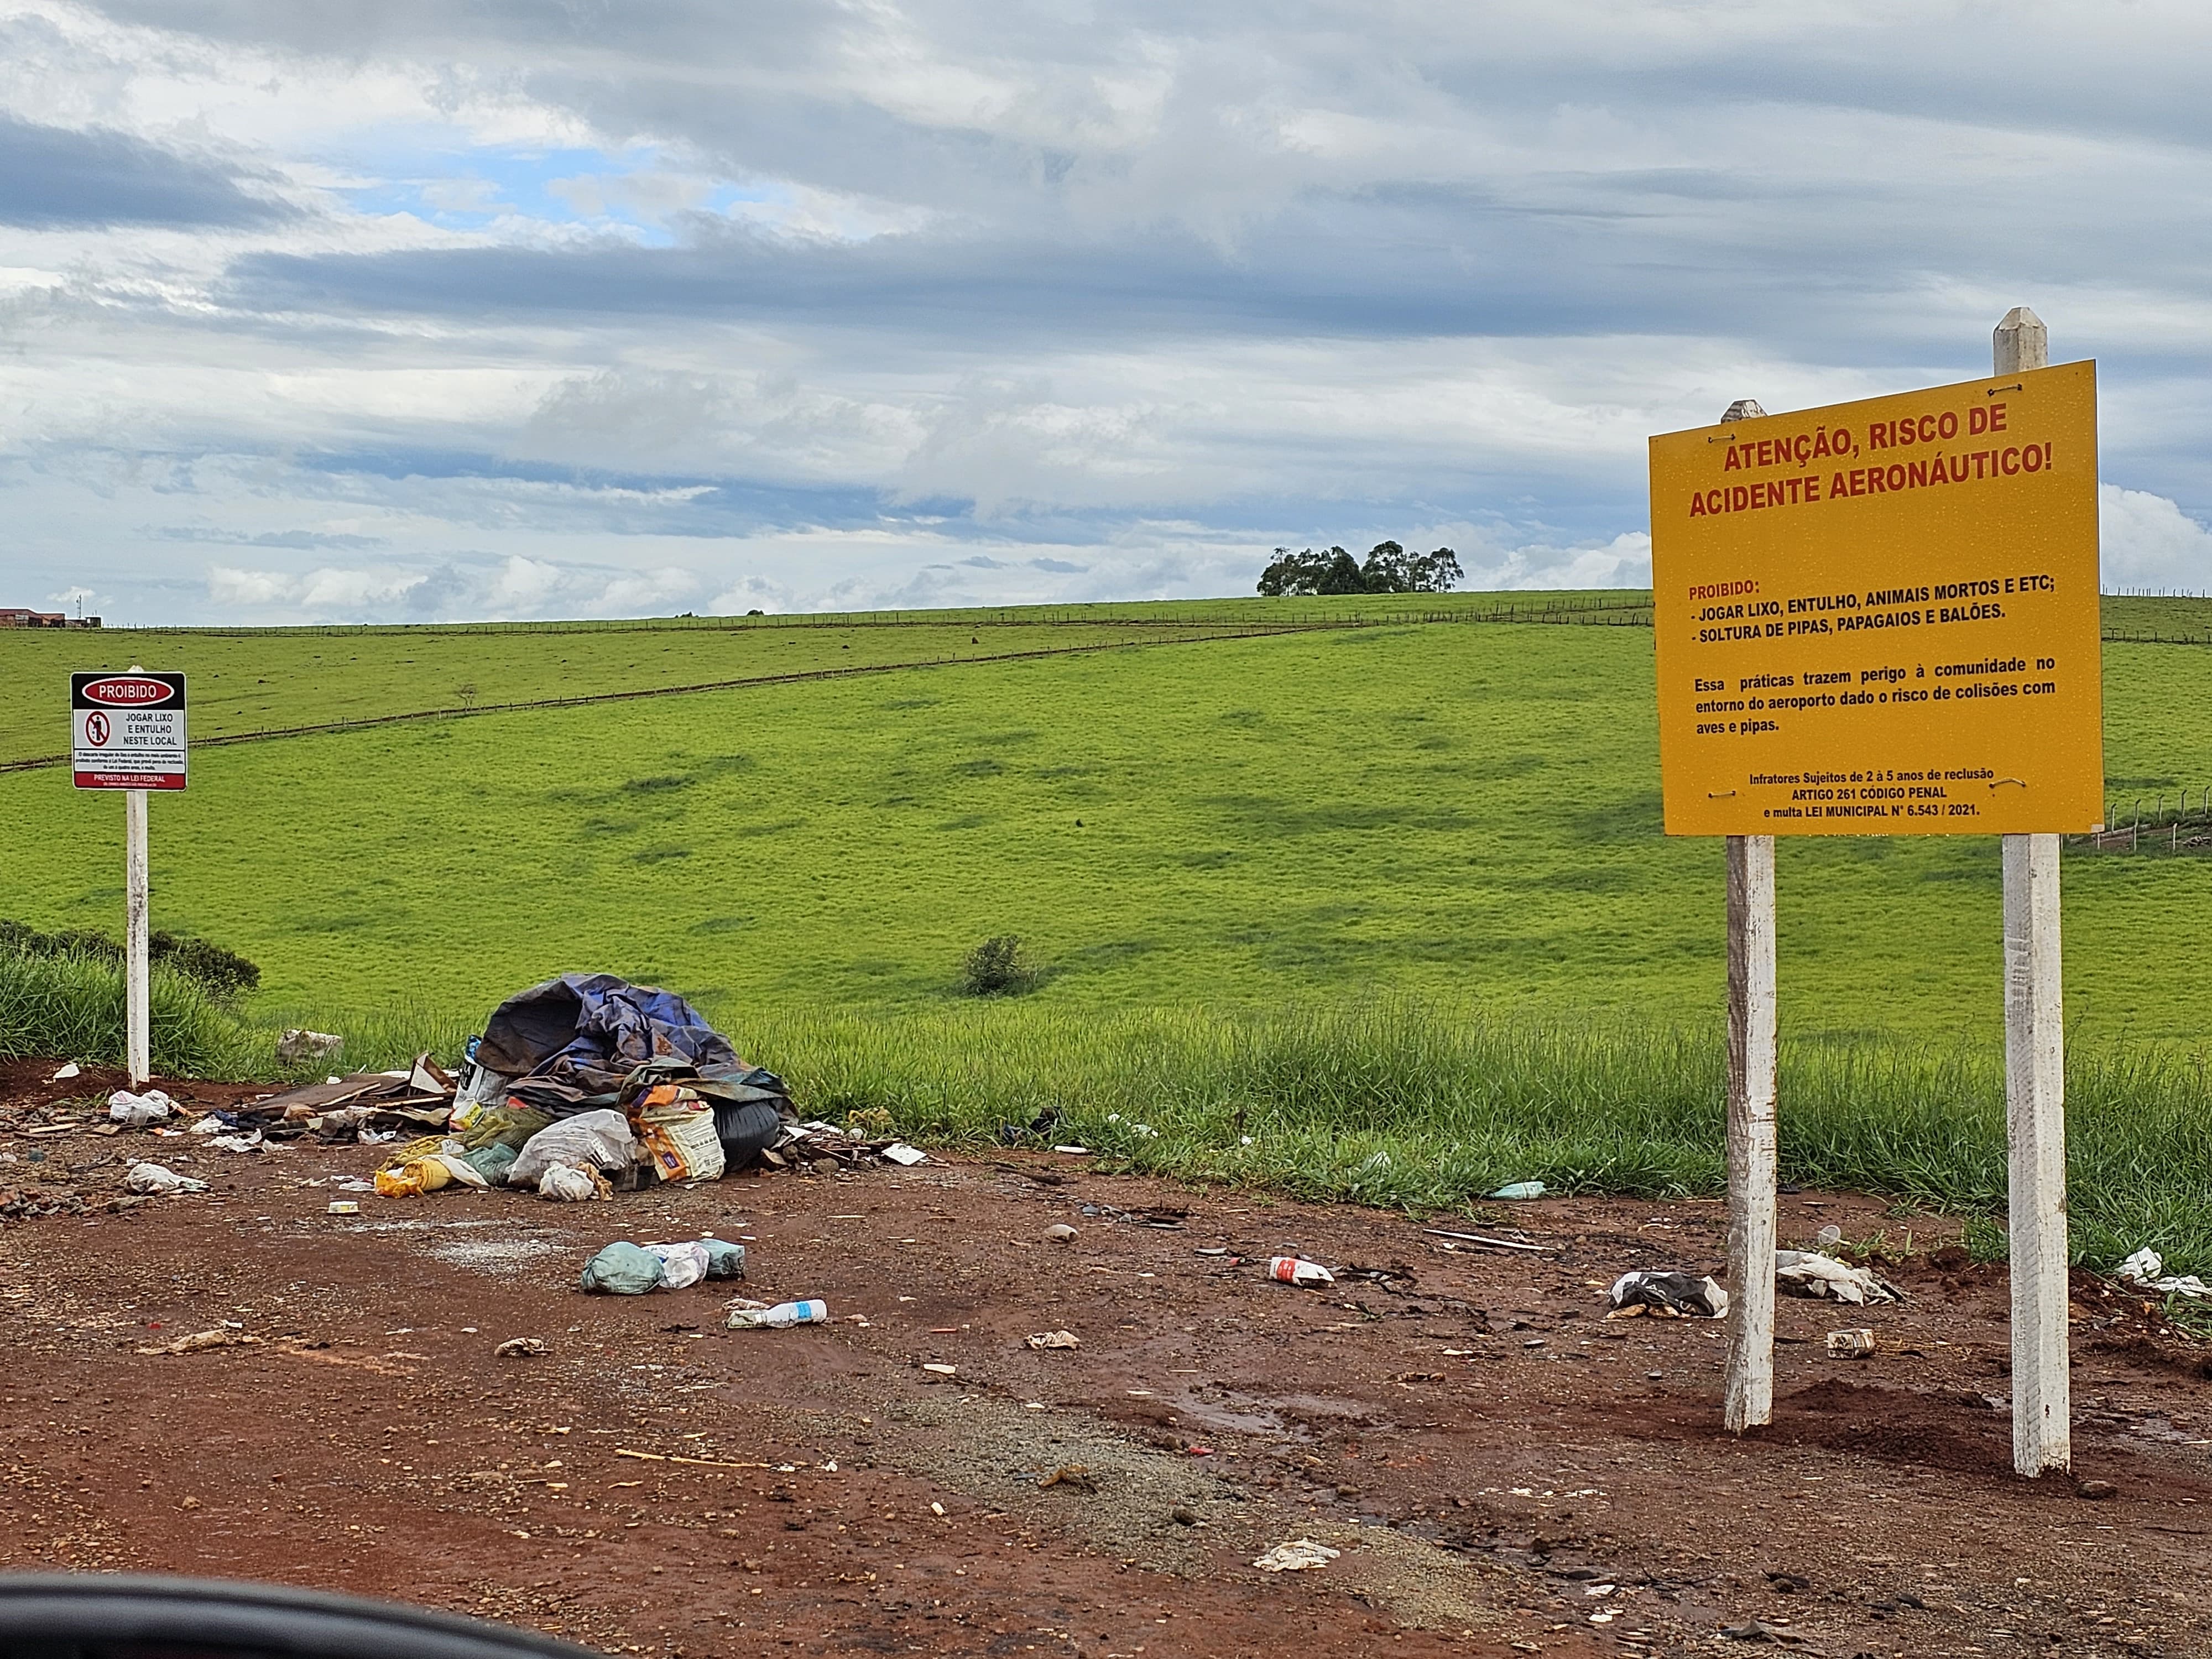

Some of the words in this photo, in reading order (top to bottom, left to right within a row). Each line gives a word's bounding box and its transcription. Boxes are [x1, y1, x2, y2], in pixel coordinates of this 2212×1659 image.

[1724, 429, 1859, 472] ATENÇÃO,
[1869, 411, 1958, 450] RISCO
[1969, 403, 2007, 436] DE
[1689, 475, 1820, 518] ACIDENTE
[1829, 442, 2052, 499] AERONÁUTICO!
[1689, 580, 1760, 601] PROIBIDO:
[1698, 604, 1744, 622] JOGAR
[1747, 601, 1783, 618] LIXO,
[1788, 594, 1861, 613] ENTULHO,
[1865, 587, 1929, 607] ANIMAIS
[1934, 579, 2000, 600] MORTOS
[2005, 578, 2015, 593] E
[2020, 575, 2054, 593] ETC;
[1699, 624, 1762, 643] SOLTURA
[1765, 622, 1784, 637] DE
[1788, 618, 1833, 635] PIPAS,
[1837, 611, 1921, 632] PAPAGAIOS
[1926, 609, 1936, 624] E
[1940, 602, 2006, 623] BALÕES.
[1694, 678, 1724, 692] Essa
[1740, 673, 1794, 693] práticas
[1803, 672, 1851, 685] trazem
[1861, 666, 1906, 685] perigo
[1916, 663, 1925, 678] à
[1934, 656, 2026, 677] comunidade
[2036, 658, 2055, 670] no
[99, 685, 157, 699] PROIBIDO
[1695, 700, 1745, 713] entorno
[1749, 696, 1765, 711] do
[1768, 693, 1835, 711] aeroporto
[1840, 690, 1875, 706] dado
[1879, 692, 1887, 703] o
[1892, 687, 1928, 702] risco
[1933, 685, 1951, 700] de
[1955, 682, 2018, 699] colisões
[2022, 682, 2056, 695] com
[126, 713, 152, 723] JOGAR
[155, 713, 174, 723] LIXO
[1697, 723, 1725, 734] aves
[1729, 722, 1736, 733] e
[1740, 718, 1779, 735] pipas.
[128, 724, 133, 734] E
[135, 724, 172, 734] ENTULHO
[123, 736, 148, 745] NESTE
[150, 737, 177, 746] LOCAL
[1750, 773, 1801, 785] Infratores
[1803, 771, 1847, 786] Sujeitos
[1849, 771, 1863, 782] de
[1866, 770, 1874, 782] 2
[1876, 770, 1884, 782] à
[1886, 770, 1893, 781] 5
[1896, 771, 1924, 781] anos
[1927, 769, 1941, 780] de
[1944, 767, 1994, 780] reclusão
[1792, 789, 1834, 801] ARTIGO
[1837, 788, 1856, 800] 261
[1860, 785, 1905, 800] CÓDIGO
[1908, 786, 1947, 799] PENAL
[1764, 809, 1770, 818] e
[1773, 806, 1802, 817] multa
[1805, 806, 1823, 817] LEI
[1825, 805, 1888, 817] MUNICIPAL
[1907, 804, 1938, 816] 6.543
[1948, 804, 1980, 816] 2021.
